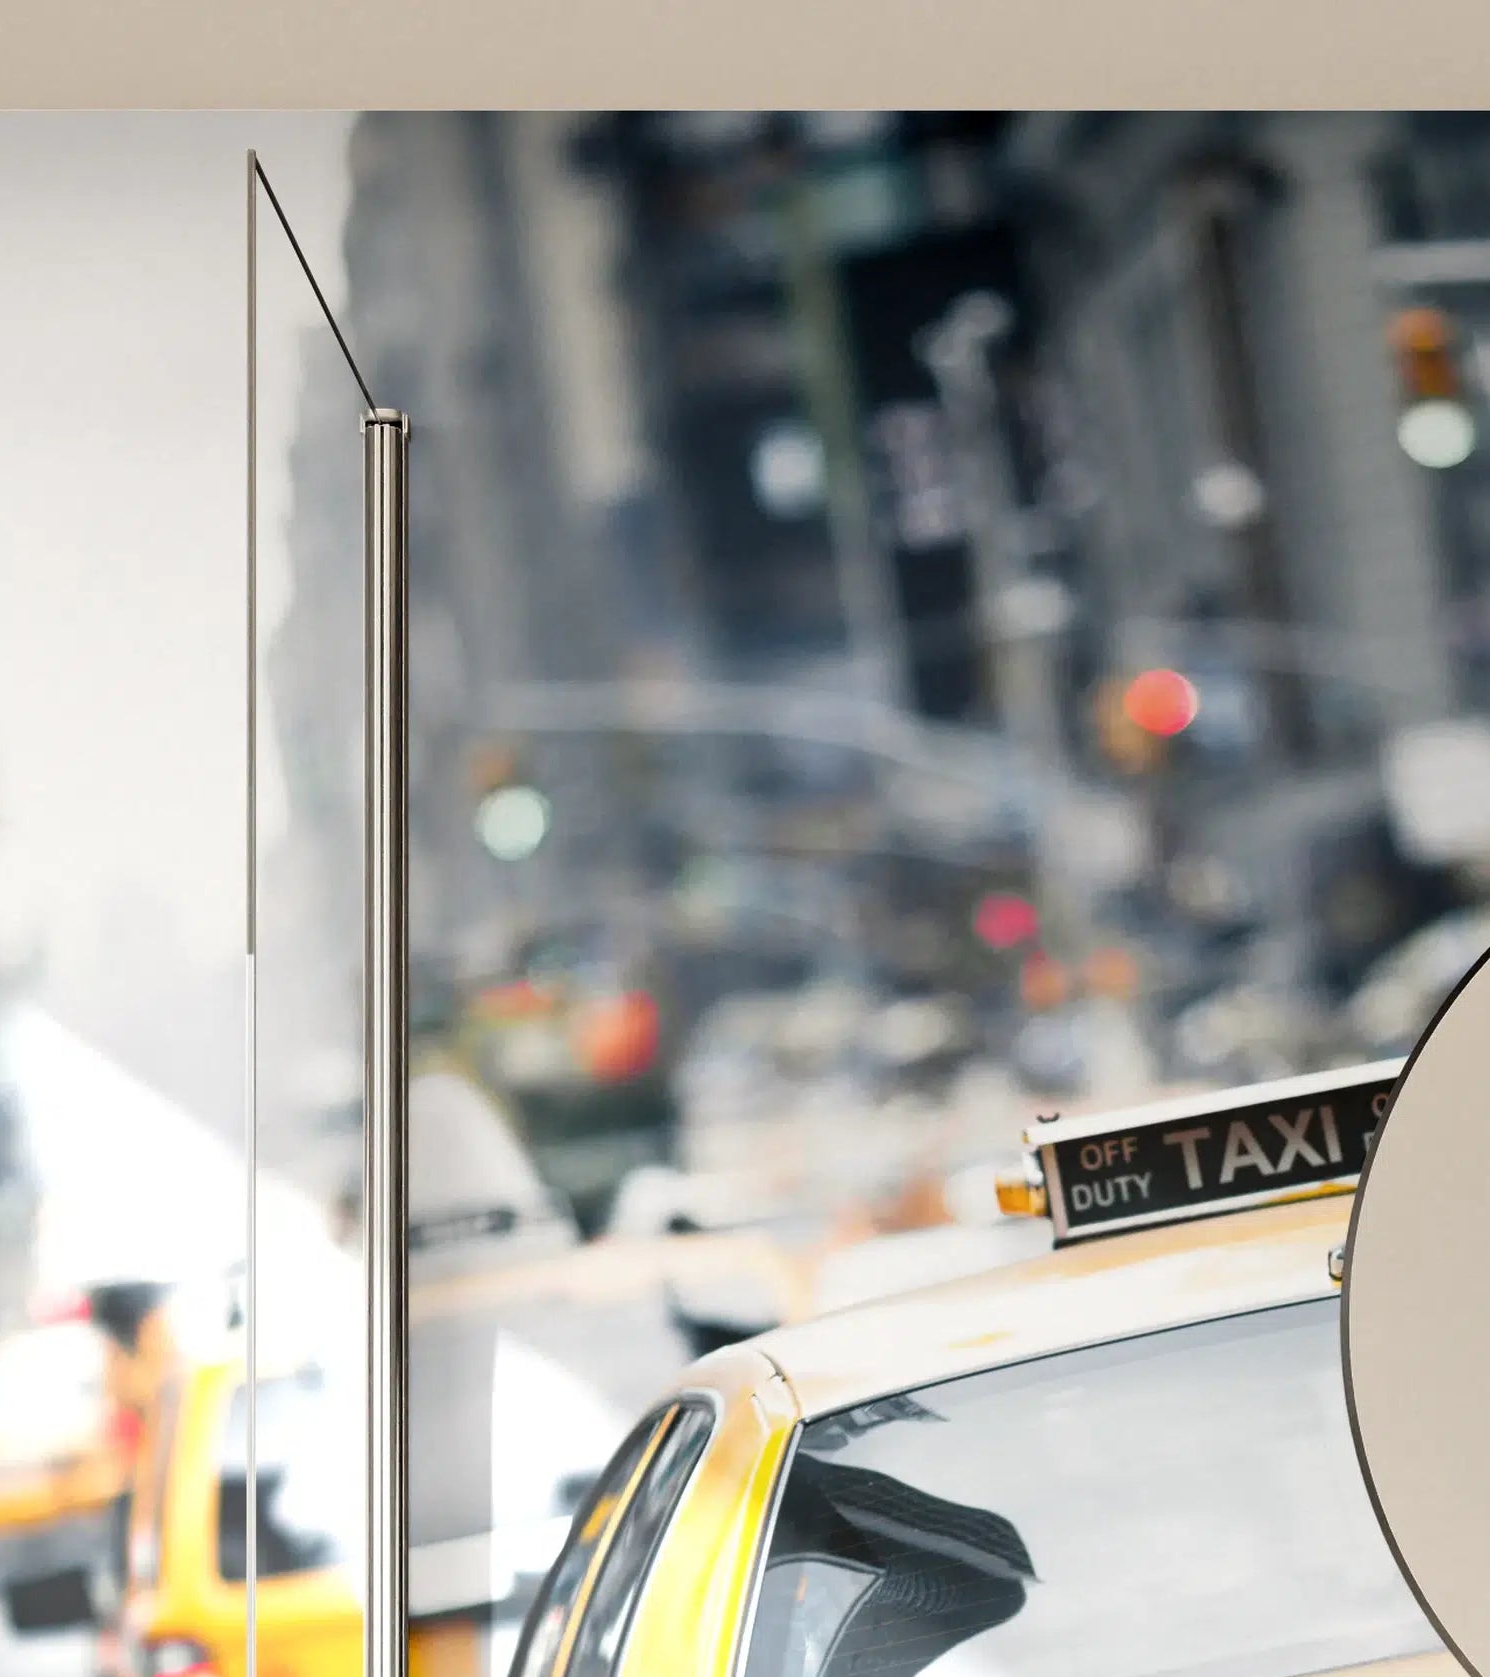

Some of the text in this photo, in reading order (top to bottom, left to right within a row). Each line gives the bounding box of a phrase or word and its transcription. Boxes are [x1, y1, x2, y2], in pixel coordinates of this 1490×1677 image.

[1080, 1136, 1138, 1171] OFF
[1162, 1106, 1343, 1189] TAXI
[1071, 1172, 1153, 1212] DUTY
